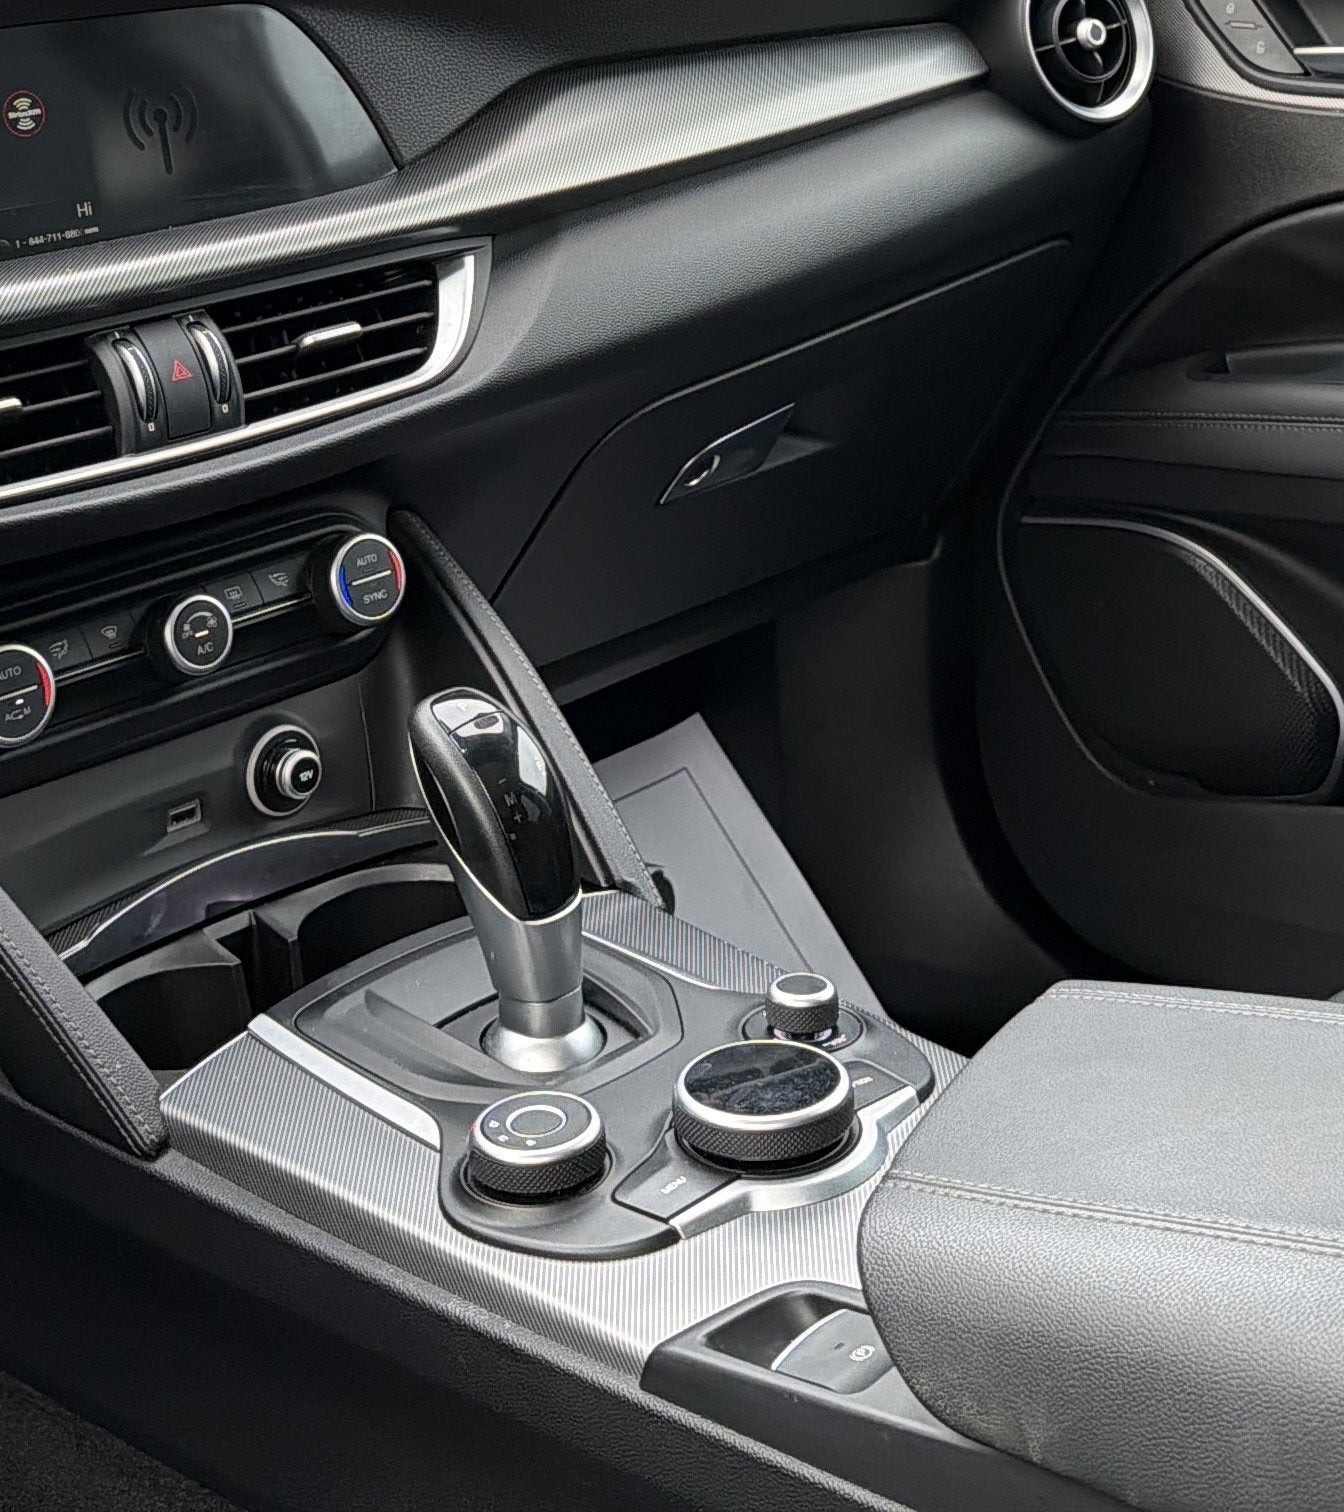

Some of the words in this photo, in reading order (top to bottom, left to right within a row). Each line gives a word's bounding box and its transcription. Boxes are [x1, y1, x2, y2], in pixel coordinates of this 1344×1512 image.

[357, 552, 378, 568] AUTO
[363, 589, 388, 605] SYNC
[197, 641, 215, 656] A/C
[299, 768, 314, 782] 12V
[504, 791, 517, 807] M
